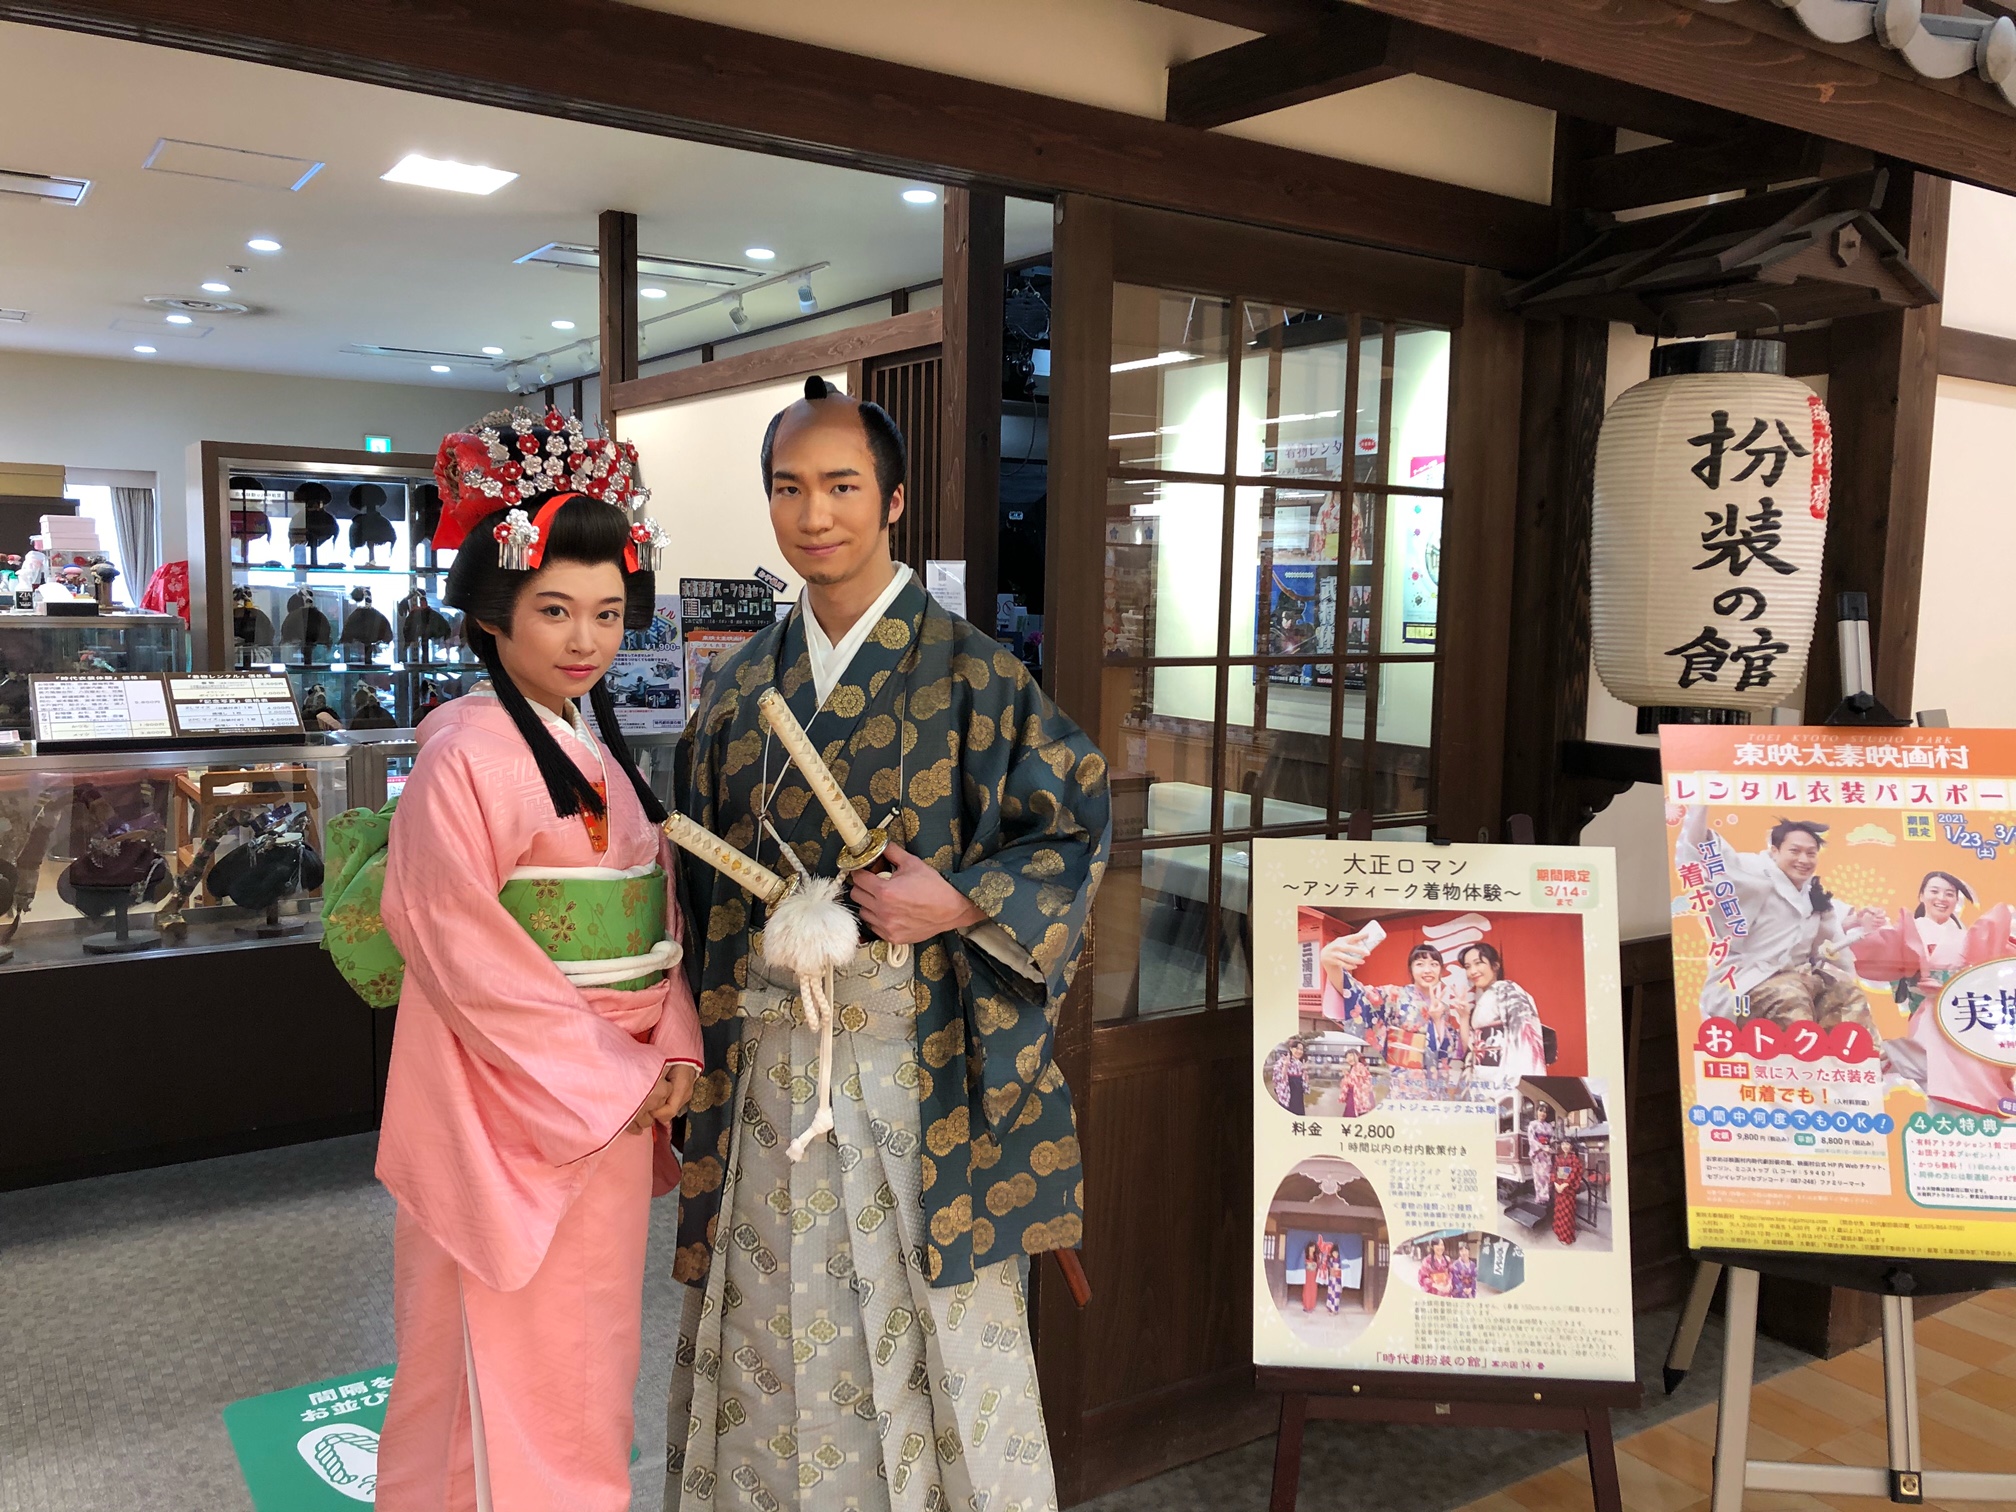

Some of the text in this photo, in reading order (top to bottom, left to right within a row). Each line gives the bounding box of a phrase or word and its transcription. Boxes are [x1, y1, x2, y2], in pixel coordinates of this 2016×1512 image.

[1663, 409, 1812, 692] 扮装の館
[1748, 733, 1953, 745] TOEI KYOTO STUDIO PARK
[1733, 743, 1969, 770] 東映太秦映画村
[1675, 780, 2004, 805] レンタル衣装パスポー
[1343, 853, 1468, 876] 大正ロマン
[1536, 868, 1591, 883] 期間限定
[1698, 841, 1748, 935] 江戸の町で
[1556, 898, 1574, 907] まで
[1754, 1065, 1877, 1084] 気に入った衣装を
[1292, 1121, 1395, 1139] 料金 ¥2,800
[1914, 1116, 1998, 1133] 4大特典
